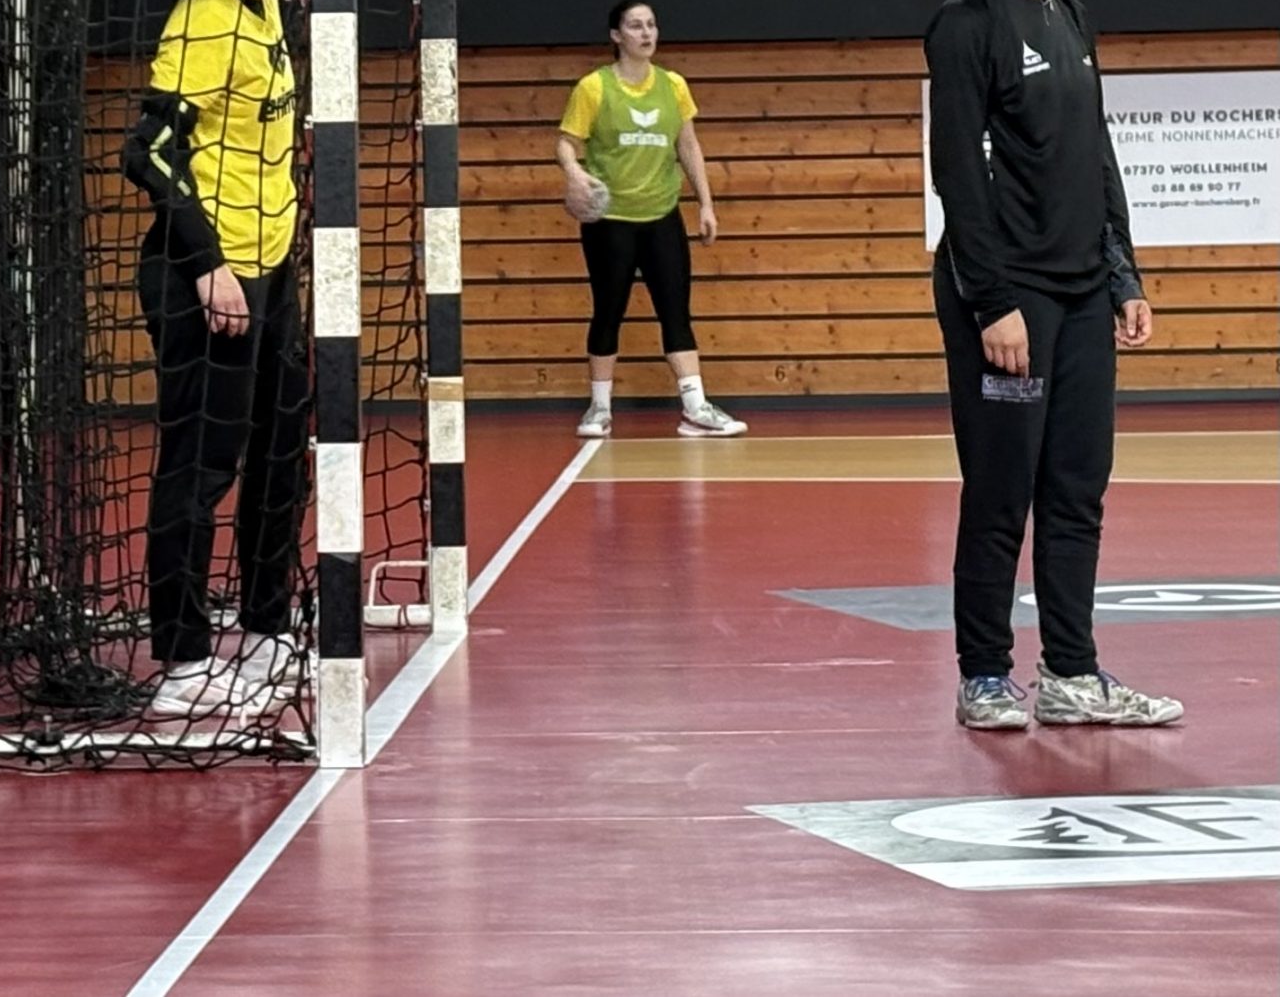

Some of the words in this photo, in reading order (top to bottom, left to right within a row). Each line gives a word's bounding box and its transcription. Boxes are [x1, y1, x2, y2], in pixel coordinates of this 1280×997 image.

[1170, 111, 1196, 123] DU
[1203, 109, 1280, 122] KOCHER
[1111, 131, 1154, 144] ERME
